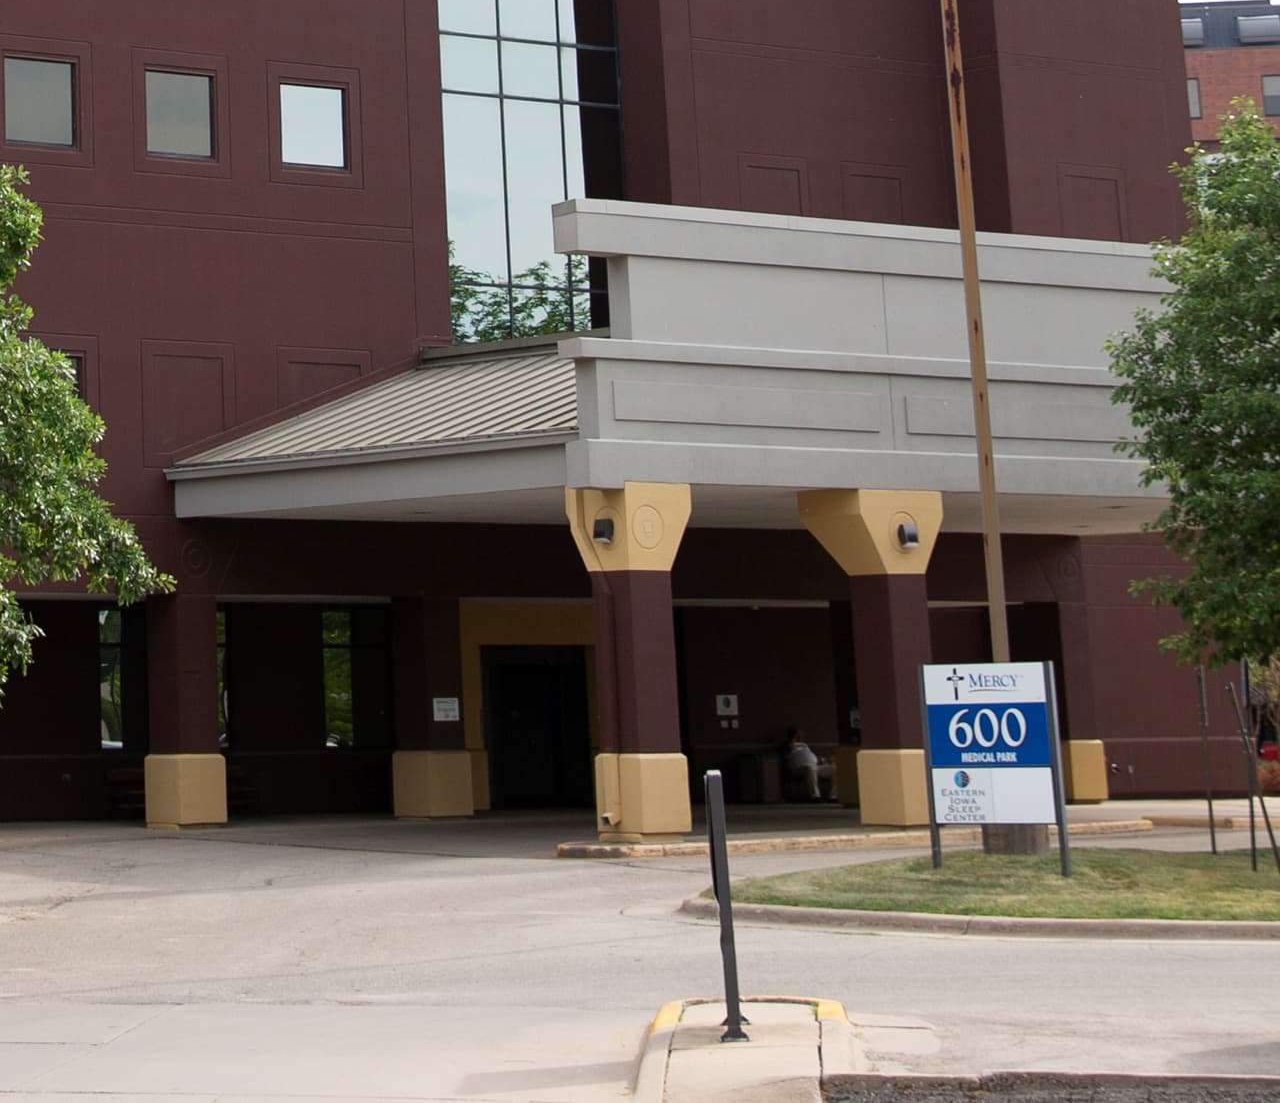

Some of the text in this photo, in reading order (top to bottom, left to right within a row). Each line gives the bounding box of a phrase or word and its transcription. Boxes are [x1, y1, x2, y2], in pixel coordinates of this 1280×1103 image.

[967, 673, 1018, 688] MERCY
[948, 707, 1027, 748] 600
[960, 752, 1018, 763] MEDICAL PARK
[941, 788, 985, 797] EASTERN
[950, 797, 977, 805] IOWA
[947, 805, 981, 813] SLEEP
[944, 813, 986, 822] CENTER
